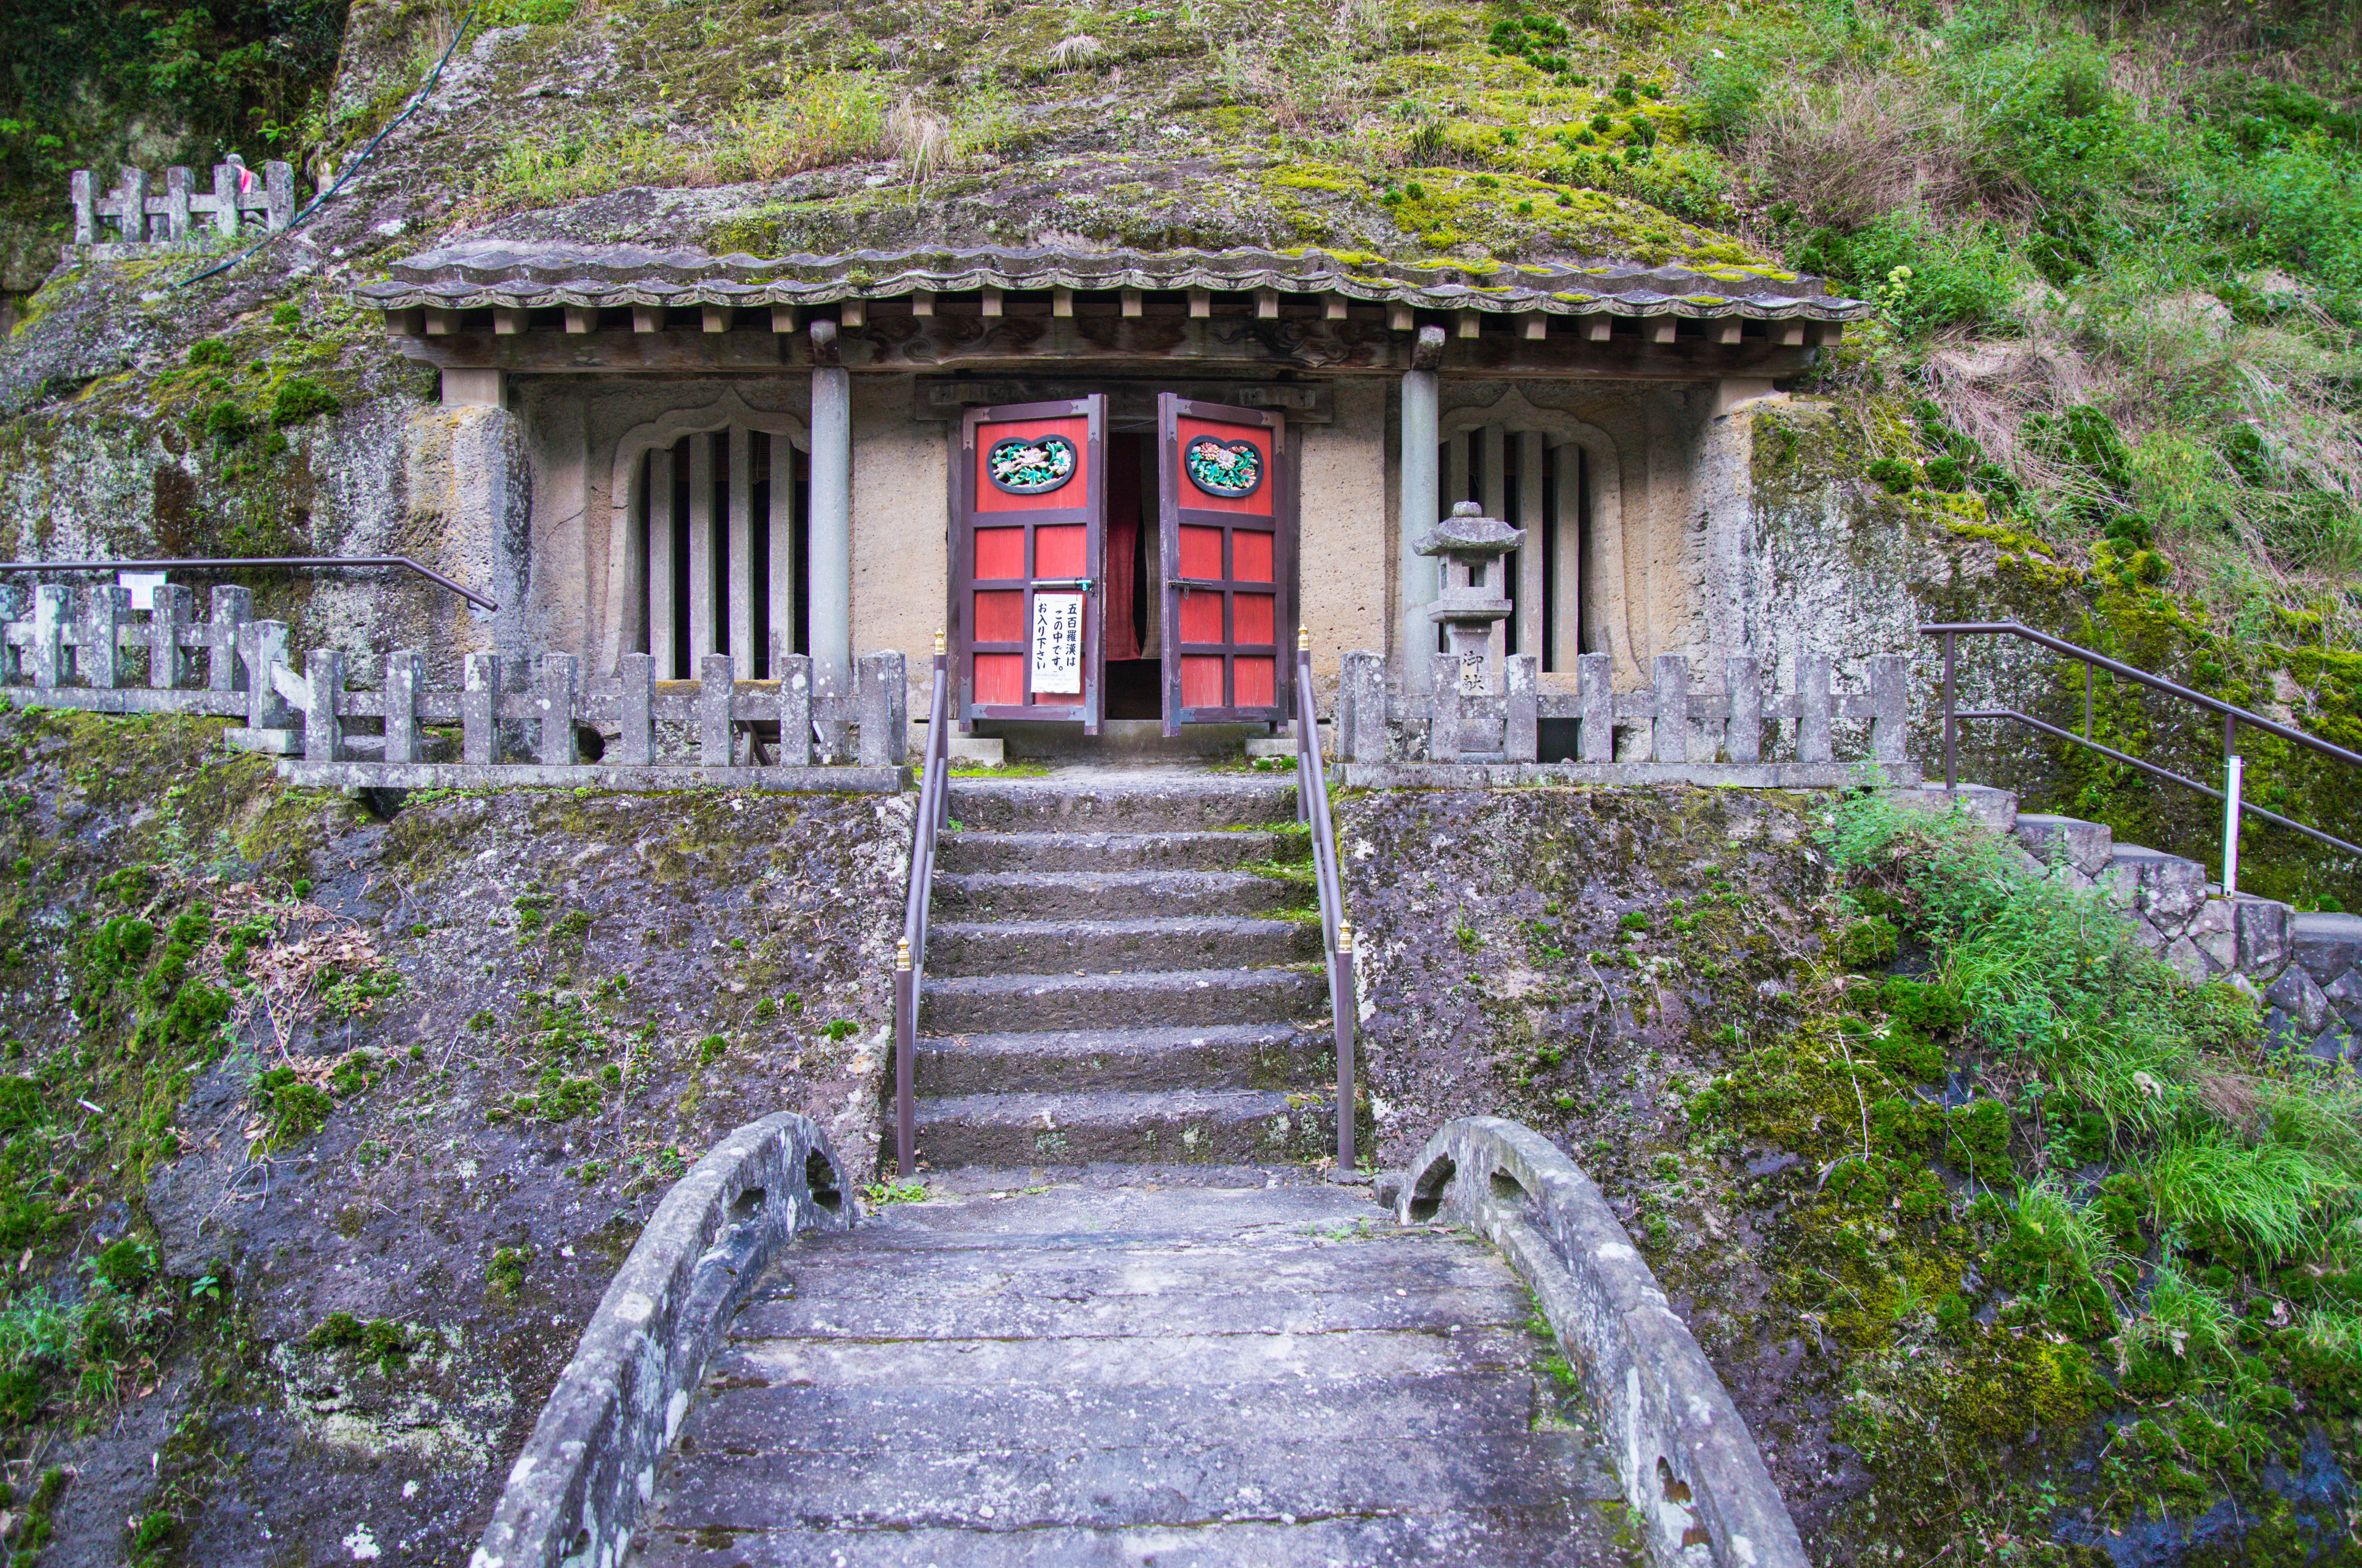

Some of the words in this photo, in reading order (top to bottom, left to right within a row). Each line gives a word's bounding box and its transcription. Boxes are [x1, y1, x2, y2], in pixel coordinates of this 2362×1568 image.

[1036, 603, 1048, 670] お入り下さい
[1052, 610, 1063, 671] この中です。
[1066, 603, 1077, 666] 五百羅漢は
